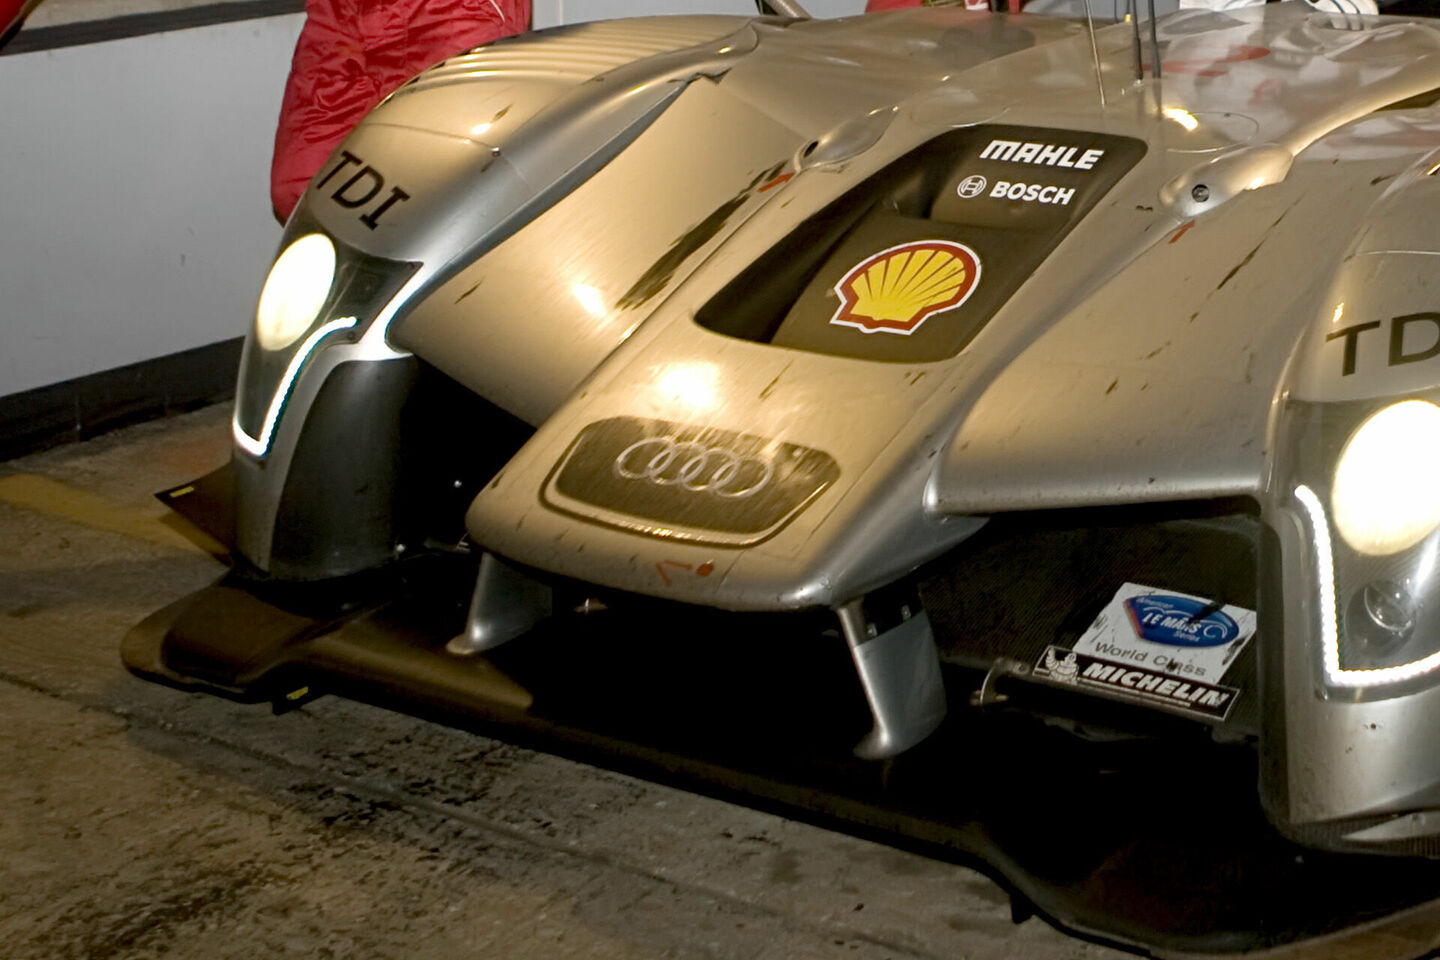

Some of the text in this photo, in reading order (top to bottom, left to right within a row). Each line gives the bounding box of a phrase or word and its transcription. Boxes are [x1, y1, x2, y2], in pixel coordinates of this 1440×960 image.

[979, 139, 1105, 170] MAHLE
[316, 150, 411, 231] TDI
[989, 181, 1076, 205] BOSCH
[1142, 612, 1162, 625] LE
[1095, 642, 1149, 662] World
[1082, 662, 1230, 708] MICHELIN
